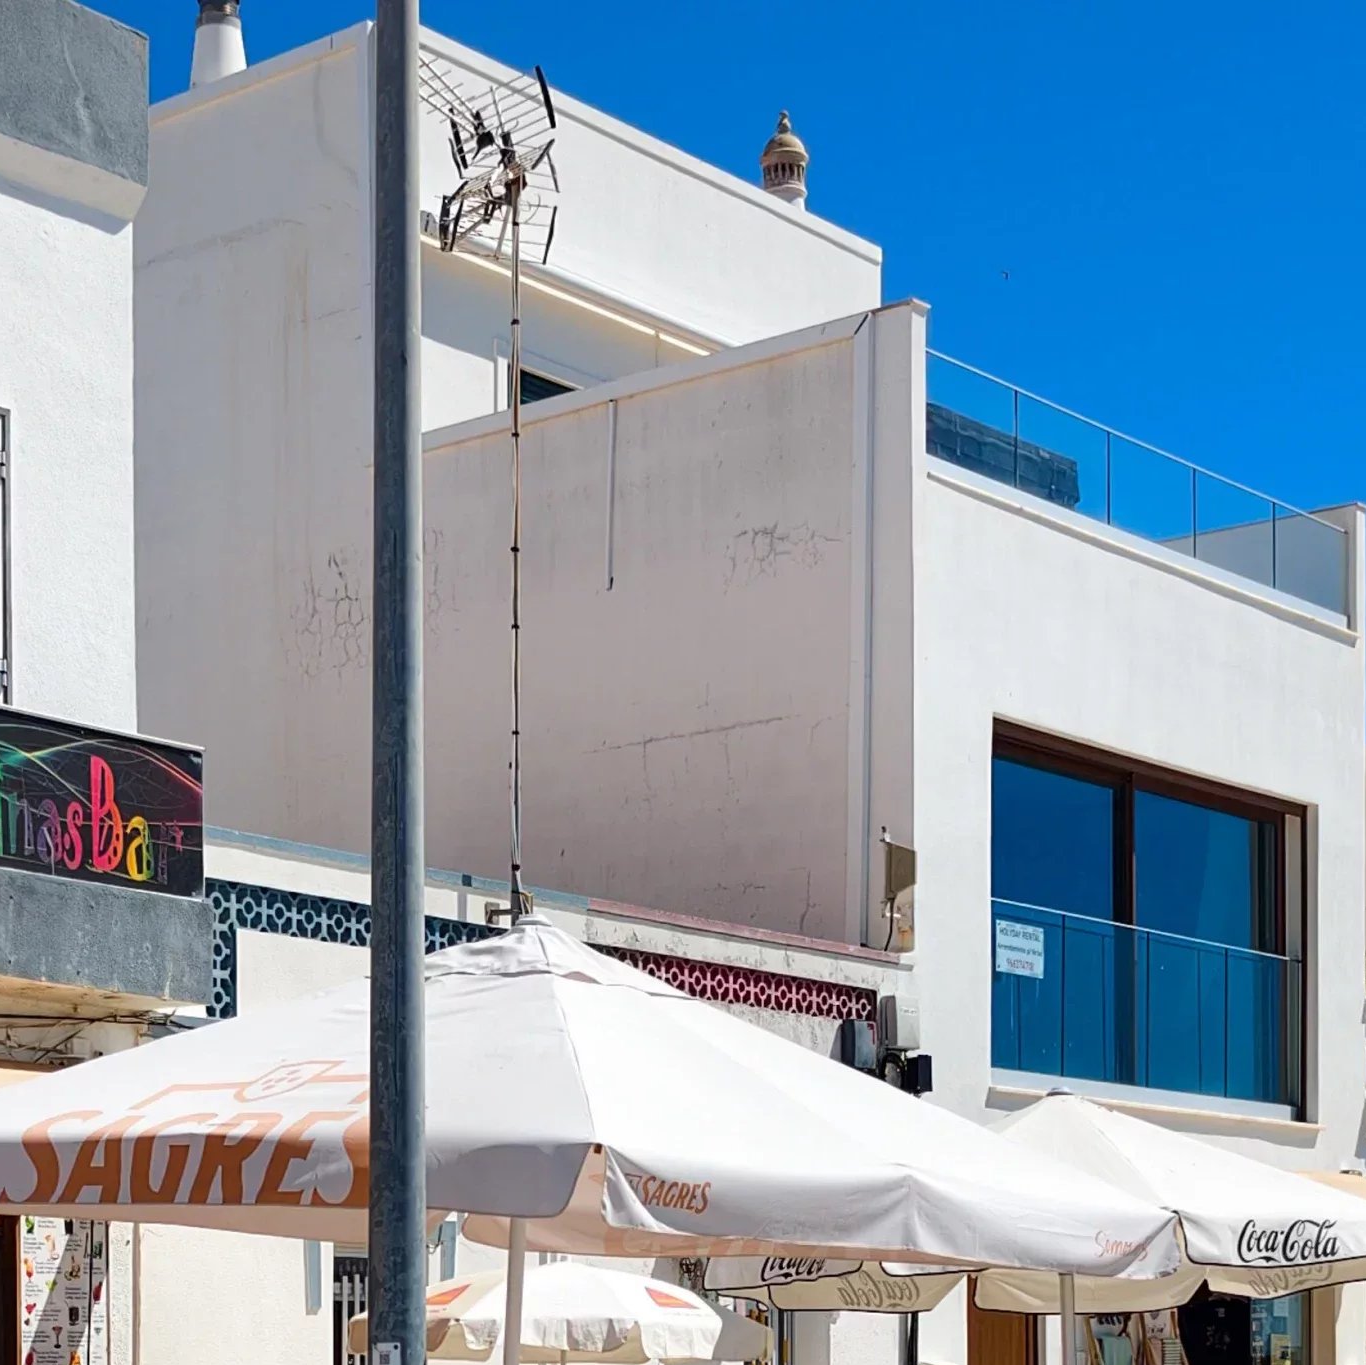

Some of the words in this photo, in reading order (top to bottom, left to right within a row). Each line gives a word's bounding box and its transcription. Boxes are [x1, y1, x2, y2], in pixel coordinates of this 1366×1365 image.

[91, 754, 184, 885] Bar
[641, 1176, 711, 1214] SAGRES
[1237, 1219, 1340, 1263] Coca-Cola
